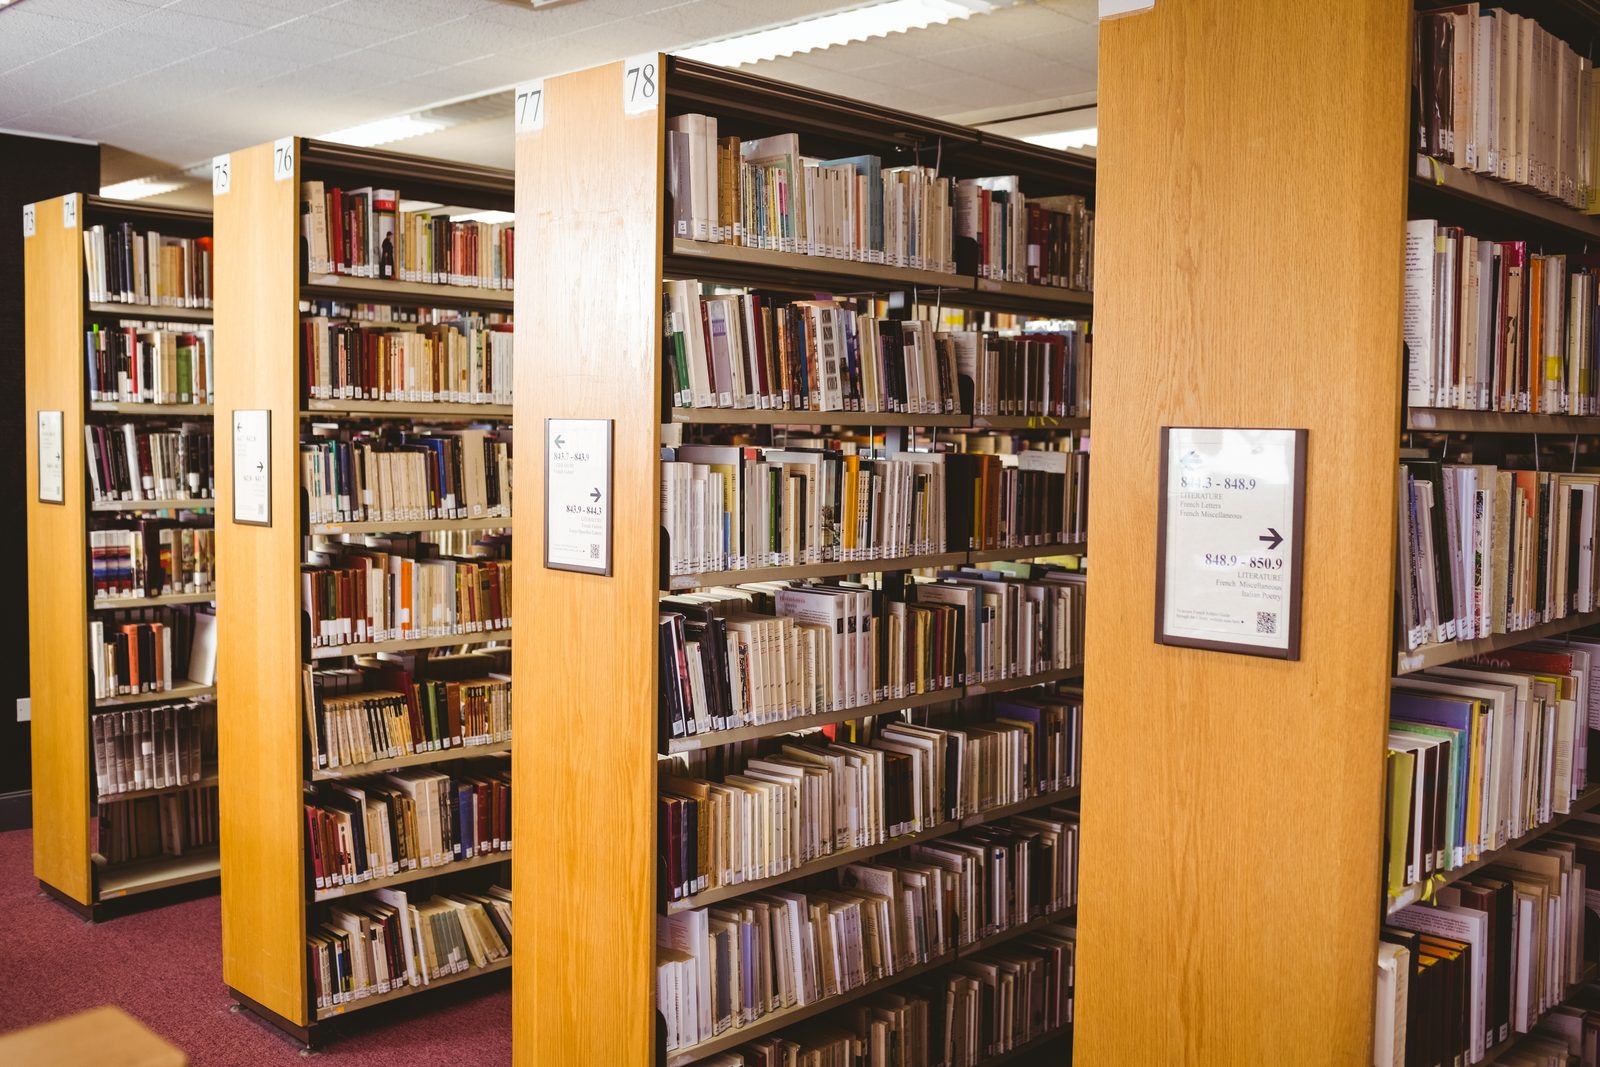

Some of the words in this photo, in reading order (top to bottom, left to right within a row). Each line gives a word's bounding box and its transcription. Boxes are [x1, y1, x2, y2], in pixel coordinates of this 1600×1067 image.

[626, 63, 655, 103] 78
[517, 89, 542, 124] 77
[276, 145, 292, 174] 76
[215, 163, 228, 189] 75
[65, 199, 75, 224] 74
[25, 211, 34, 231] 73
[1181, 476, 1212, 489] 8.3
[1224, 477, 1256, 490] 848.9
[1180, 491, 1224, 500] LITERATURE
[566, 504, 582, 514] 843.9
[1180, 501, 1200, 509] French
[1201, 510, 1242, 519] Miscellaneous
[1205, 553, 1237, 566] 848.9
[1250, 557, 1283, 570] 850.9
[1237, 571, 1282, 581] LITERATURE
[1216, 578, 1236, 587] French
[1240, 580, 1282, 590] Miscellaneous
[1241, 590, 1260, 598] Italian
[1262, 592, 1281, 602] Poetry
